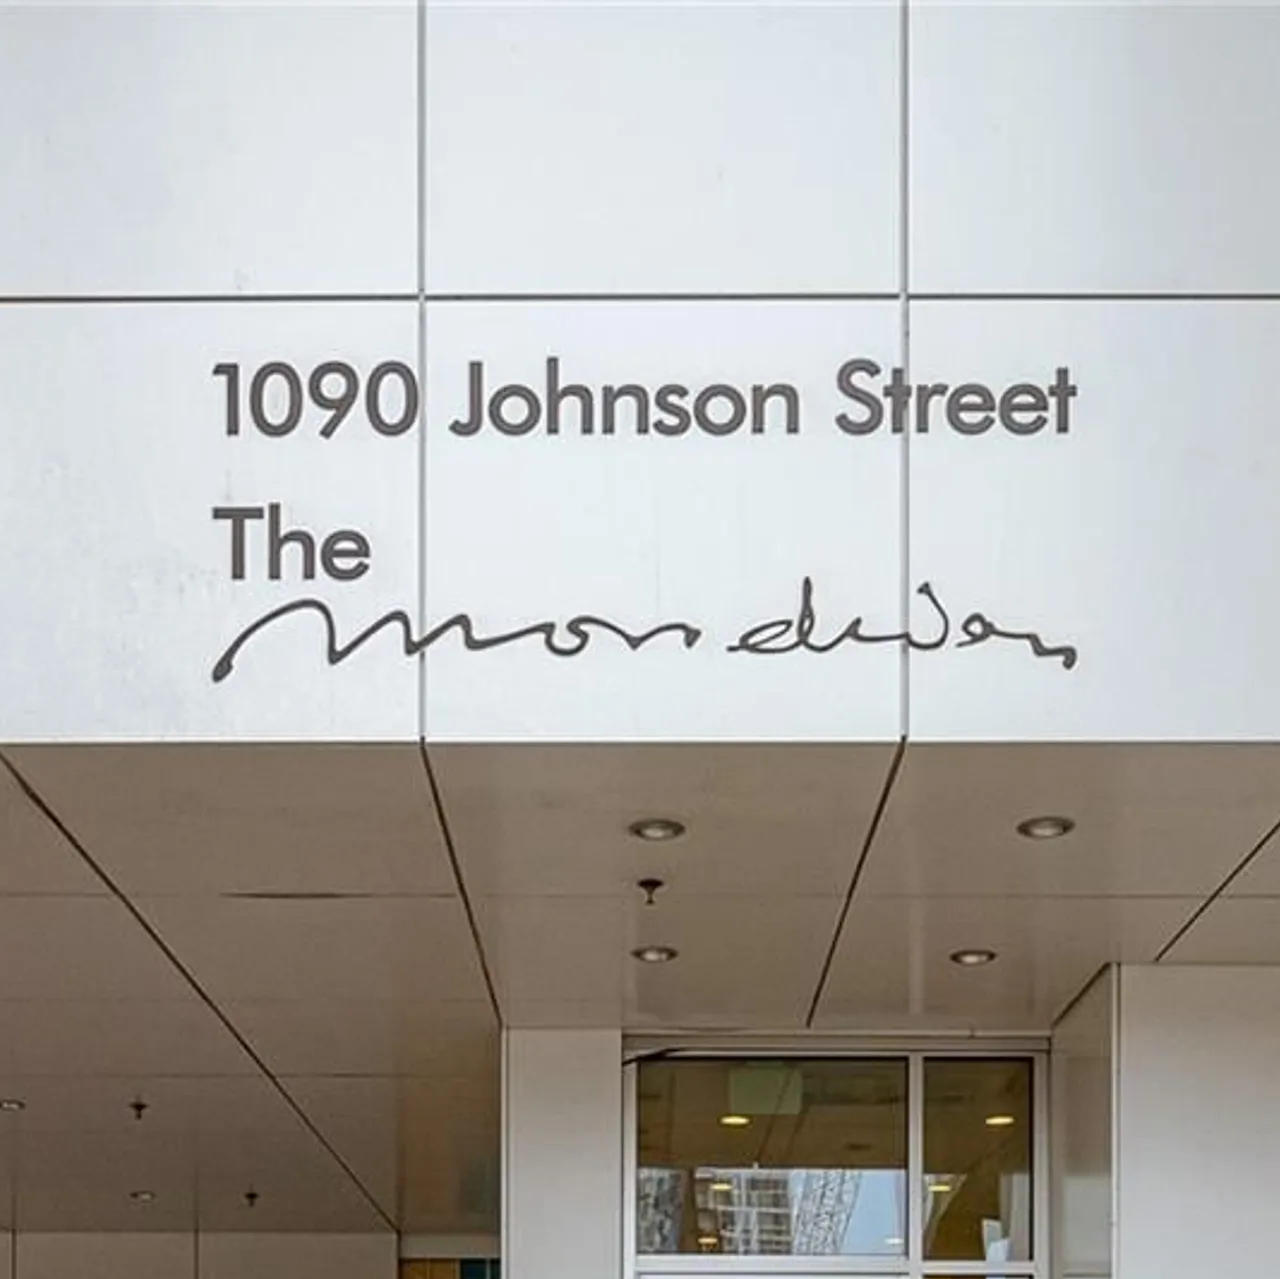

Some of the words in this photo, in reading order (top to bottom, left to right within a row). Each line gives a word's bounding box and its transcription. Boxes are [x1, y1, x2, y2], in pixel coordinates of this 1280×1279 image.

[212, 361, 419, 439] 1090
[448, 357, 800, 437] Johnson
[835, 358, 1078, 436] Street
[212, 502, 371, 581] The
